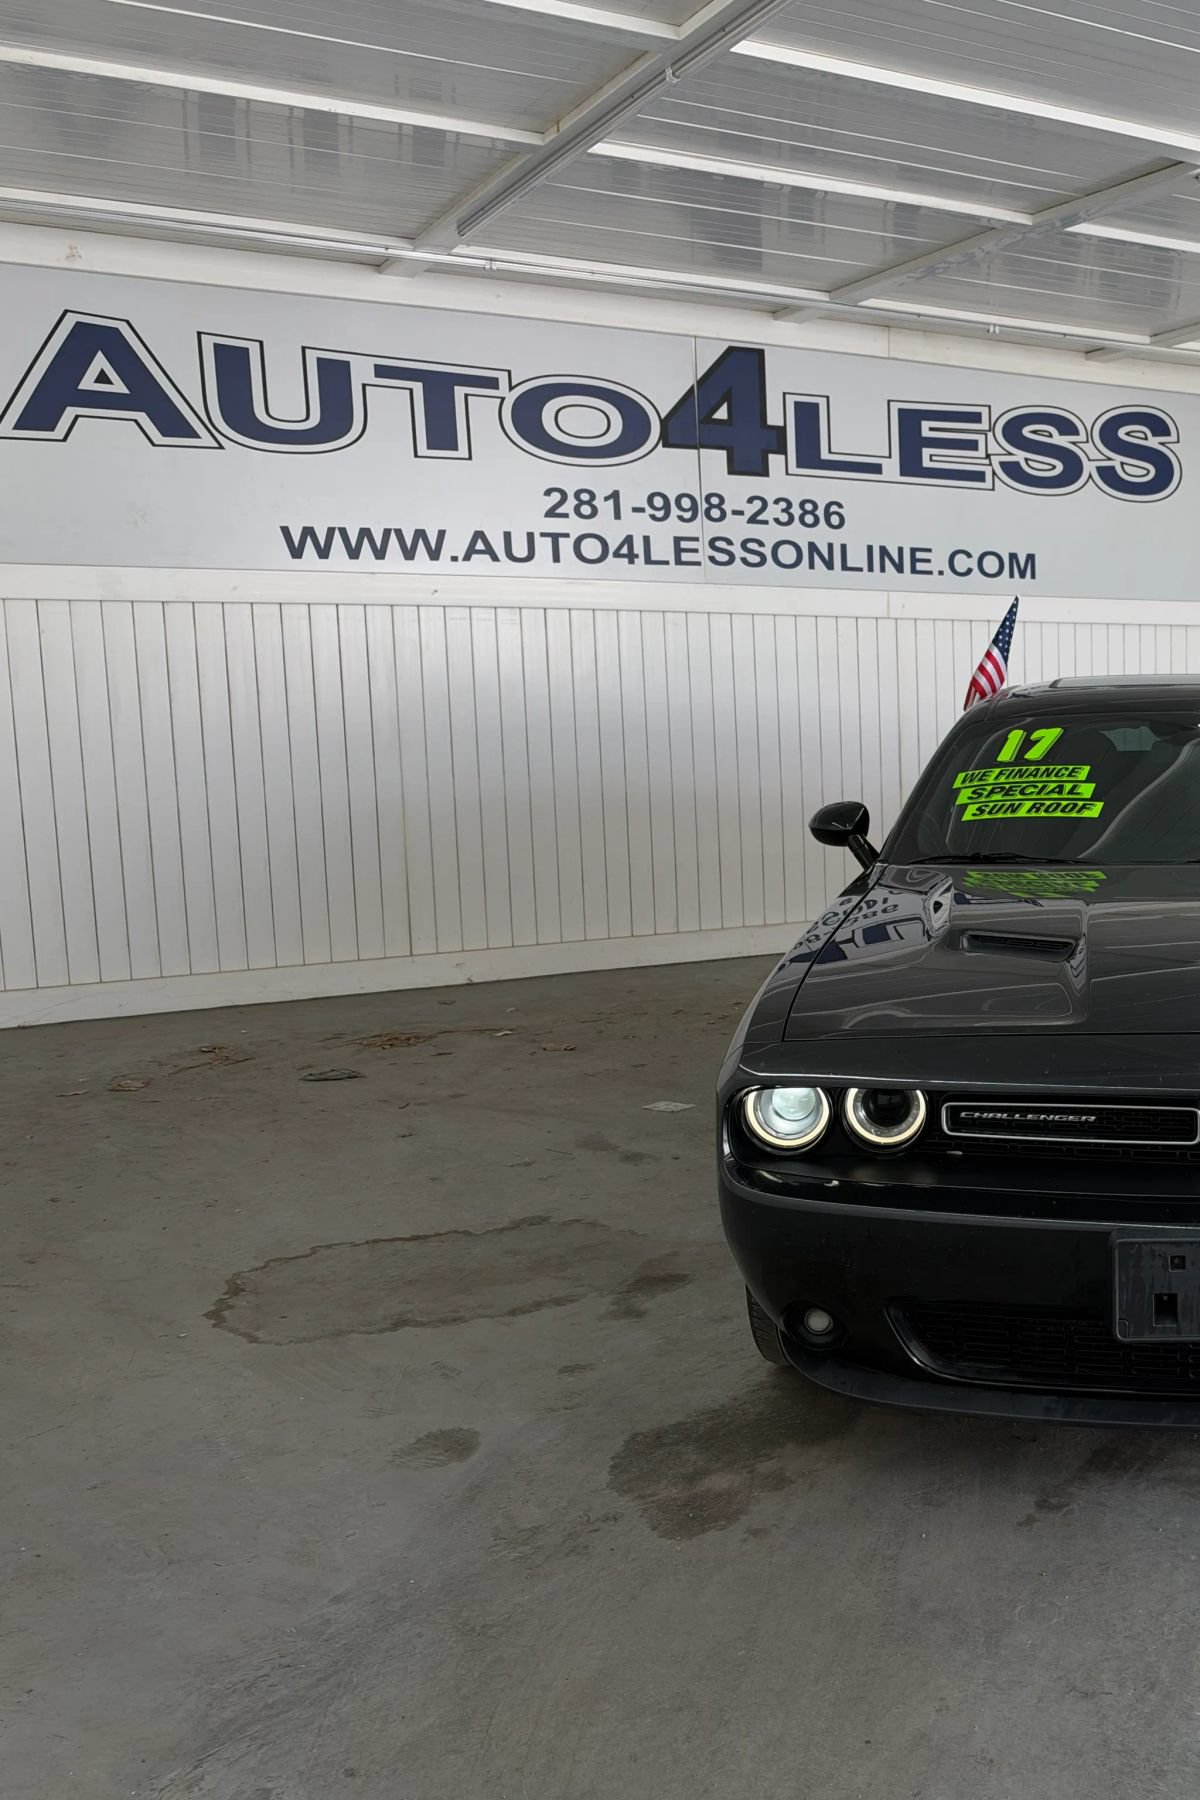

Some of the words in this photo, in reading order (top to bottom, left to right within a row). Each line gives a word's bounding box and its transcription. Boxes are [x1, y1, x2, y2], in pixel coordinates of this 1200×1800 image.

[0, 309, 1183, 503] AUTO4LESS
[543, 486, 847, 530] 281-998-2386
[280, 525, 1037, 581] WWW.AUTO4LESSONLINE.COM
[997, 728, 1064, 762] 17
[961, 771, 993, 785] WE
[994, 766, 1082, 780] FINANCE
[968, 784, 1083, 800] SPECIAL
[972, 802, 1024, 816] SUN
[1028, 802, 1096, 815] ROOF
[960, 1111, 1096, 1122] CHALLENGER
